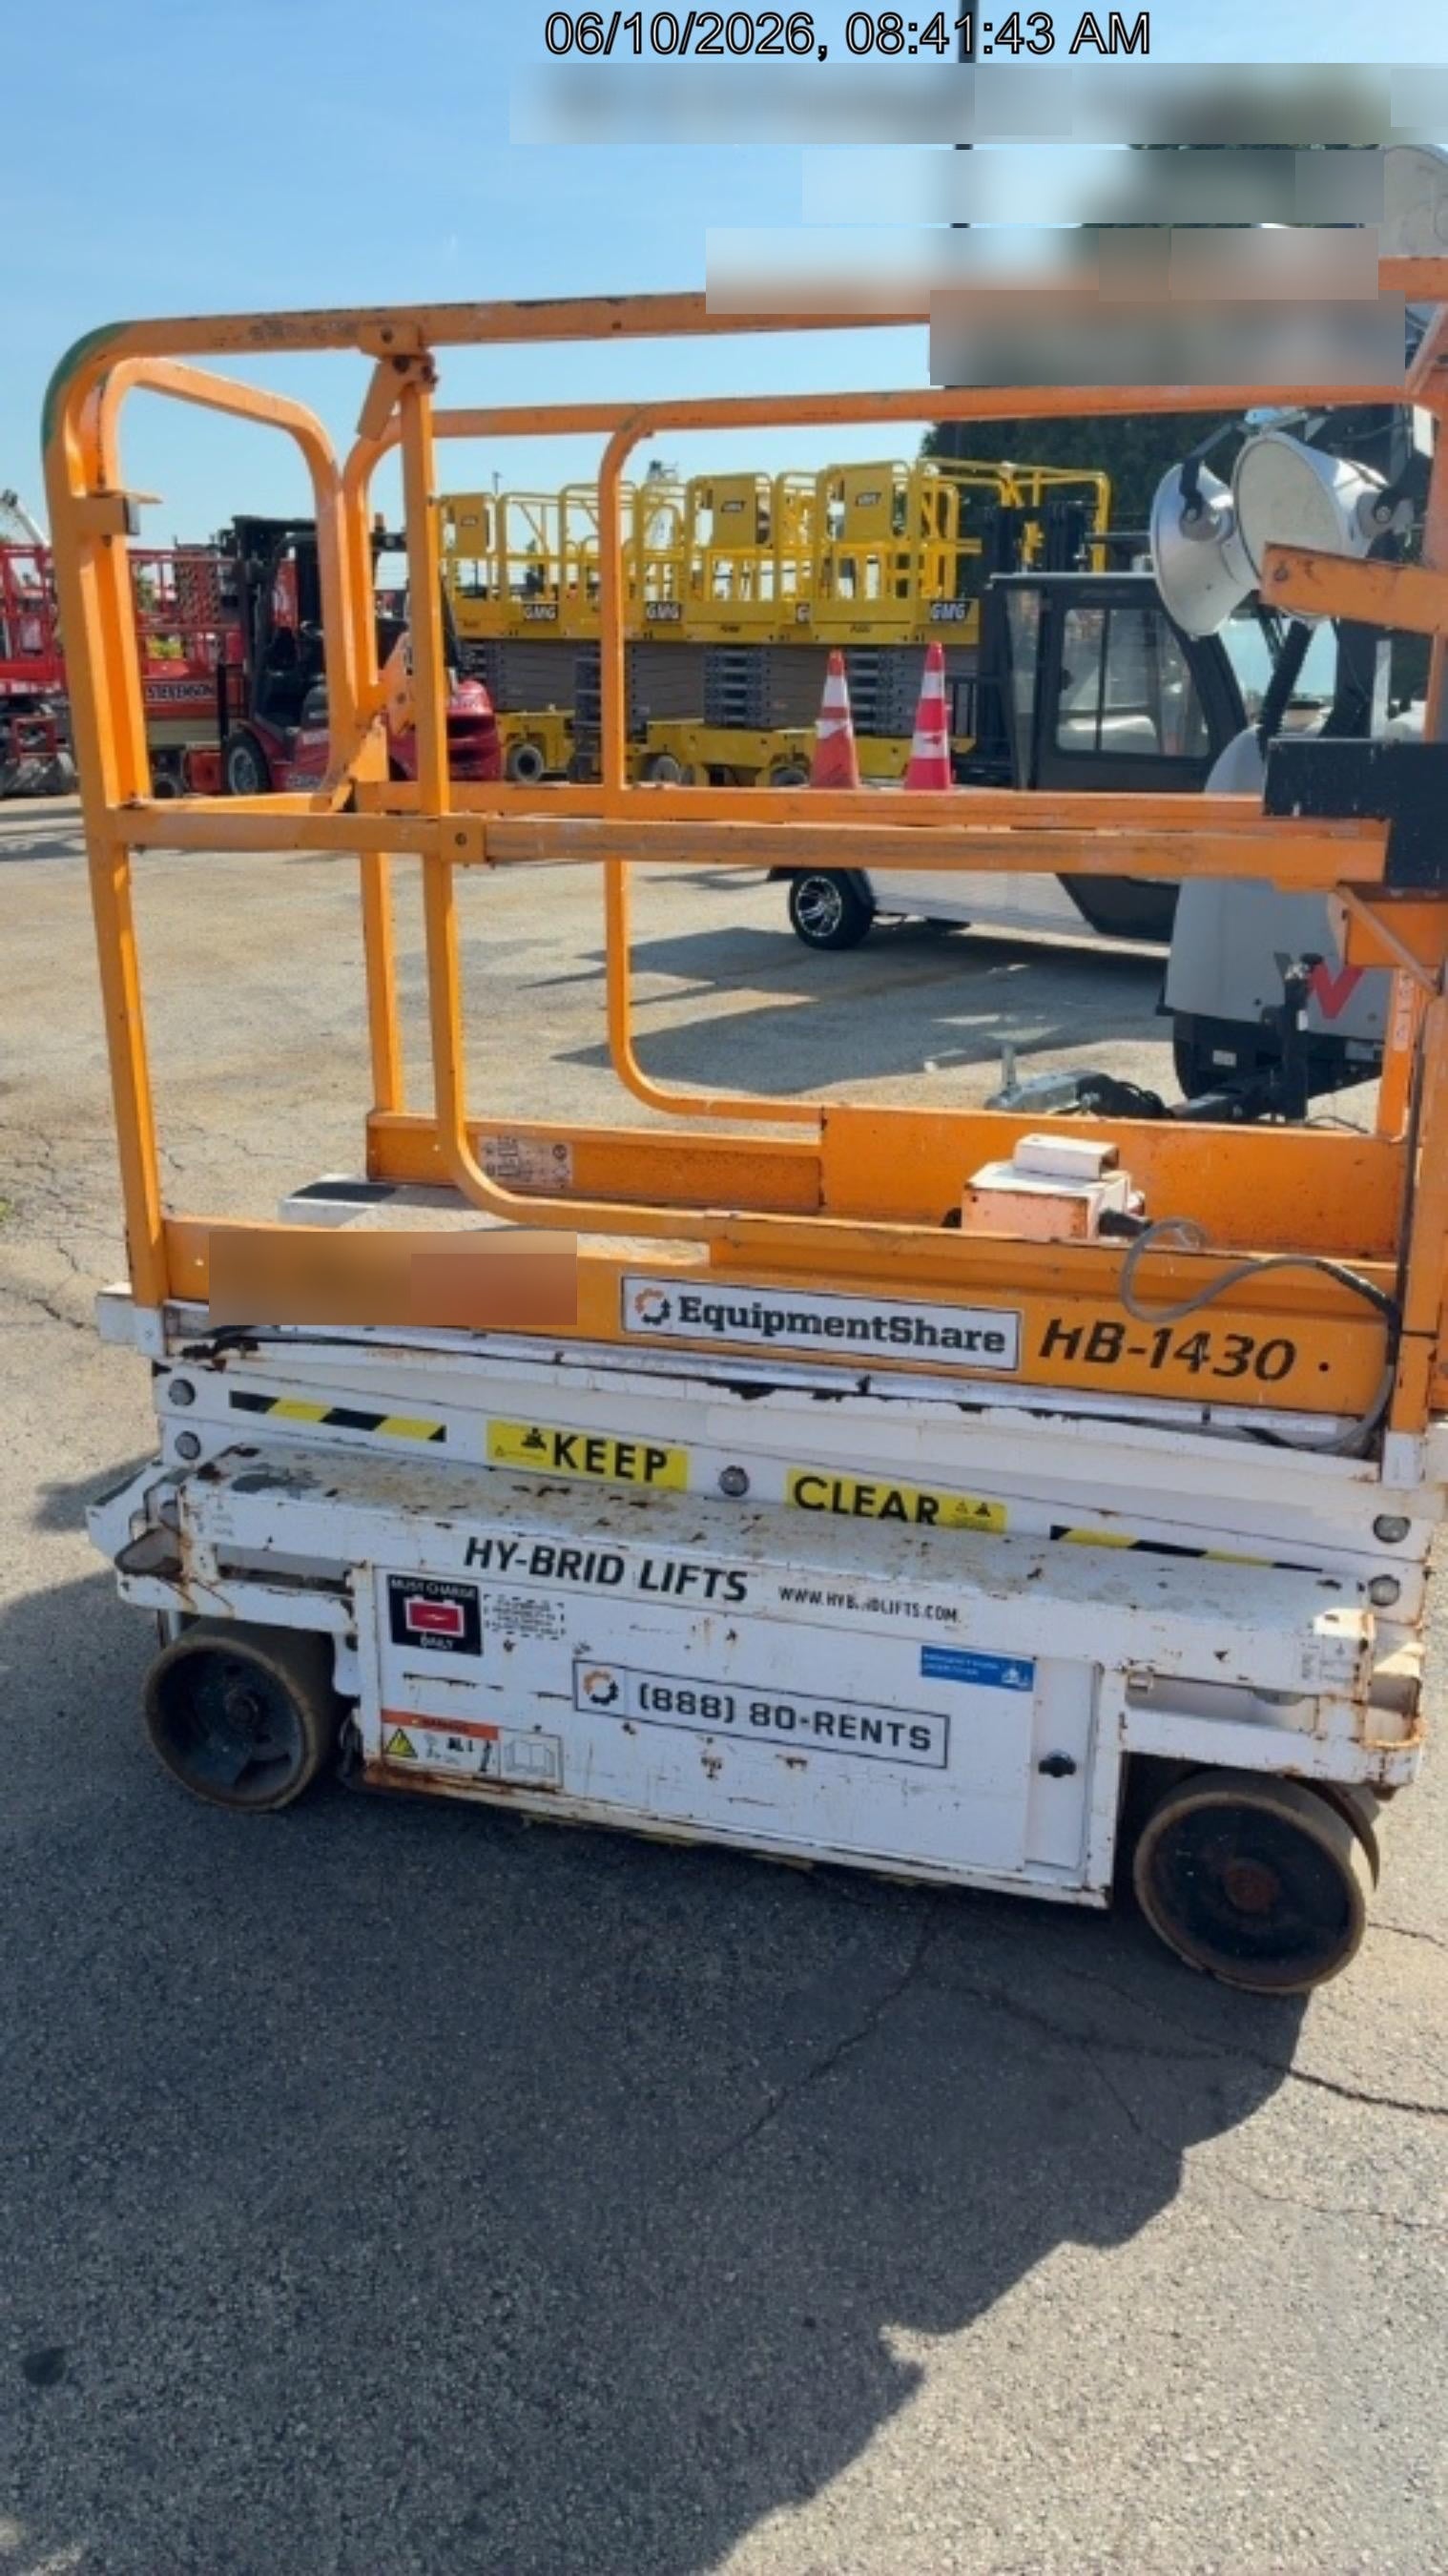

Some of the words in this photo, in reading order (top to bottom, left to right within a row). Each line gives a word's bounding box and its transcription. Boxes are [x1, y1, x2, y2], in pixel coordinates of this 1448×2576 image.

[930, 602, 967, 620] GMG
[678, 1294, 1006, 1354] EquipmentShare
[1038, 1318, 1297, 1381] HB-1430
[553, 1431, 668, 1483] KEEP
[794, 1476, 940, 1526] CLEAR
[464, 1536, 626, 1586] HY-BRID
[638, 1559, 749, 1602] LIFTS
[639, 1682, 735, 1724] (888)
[749, 1701, 932, 1752] 80-RENTS
